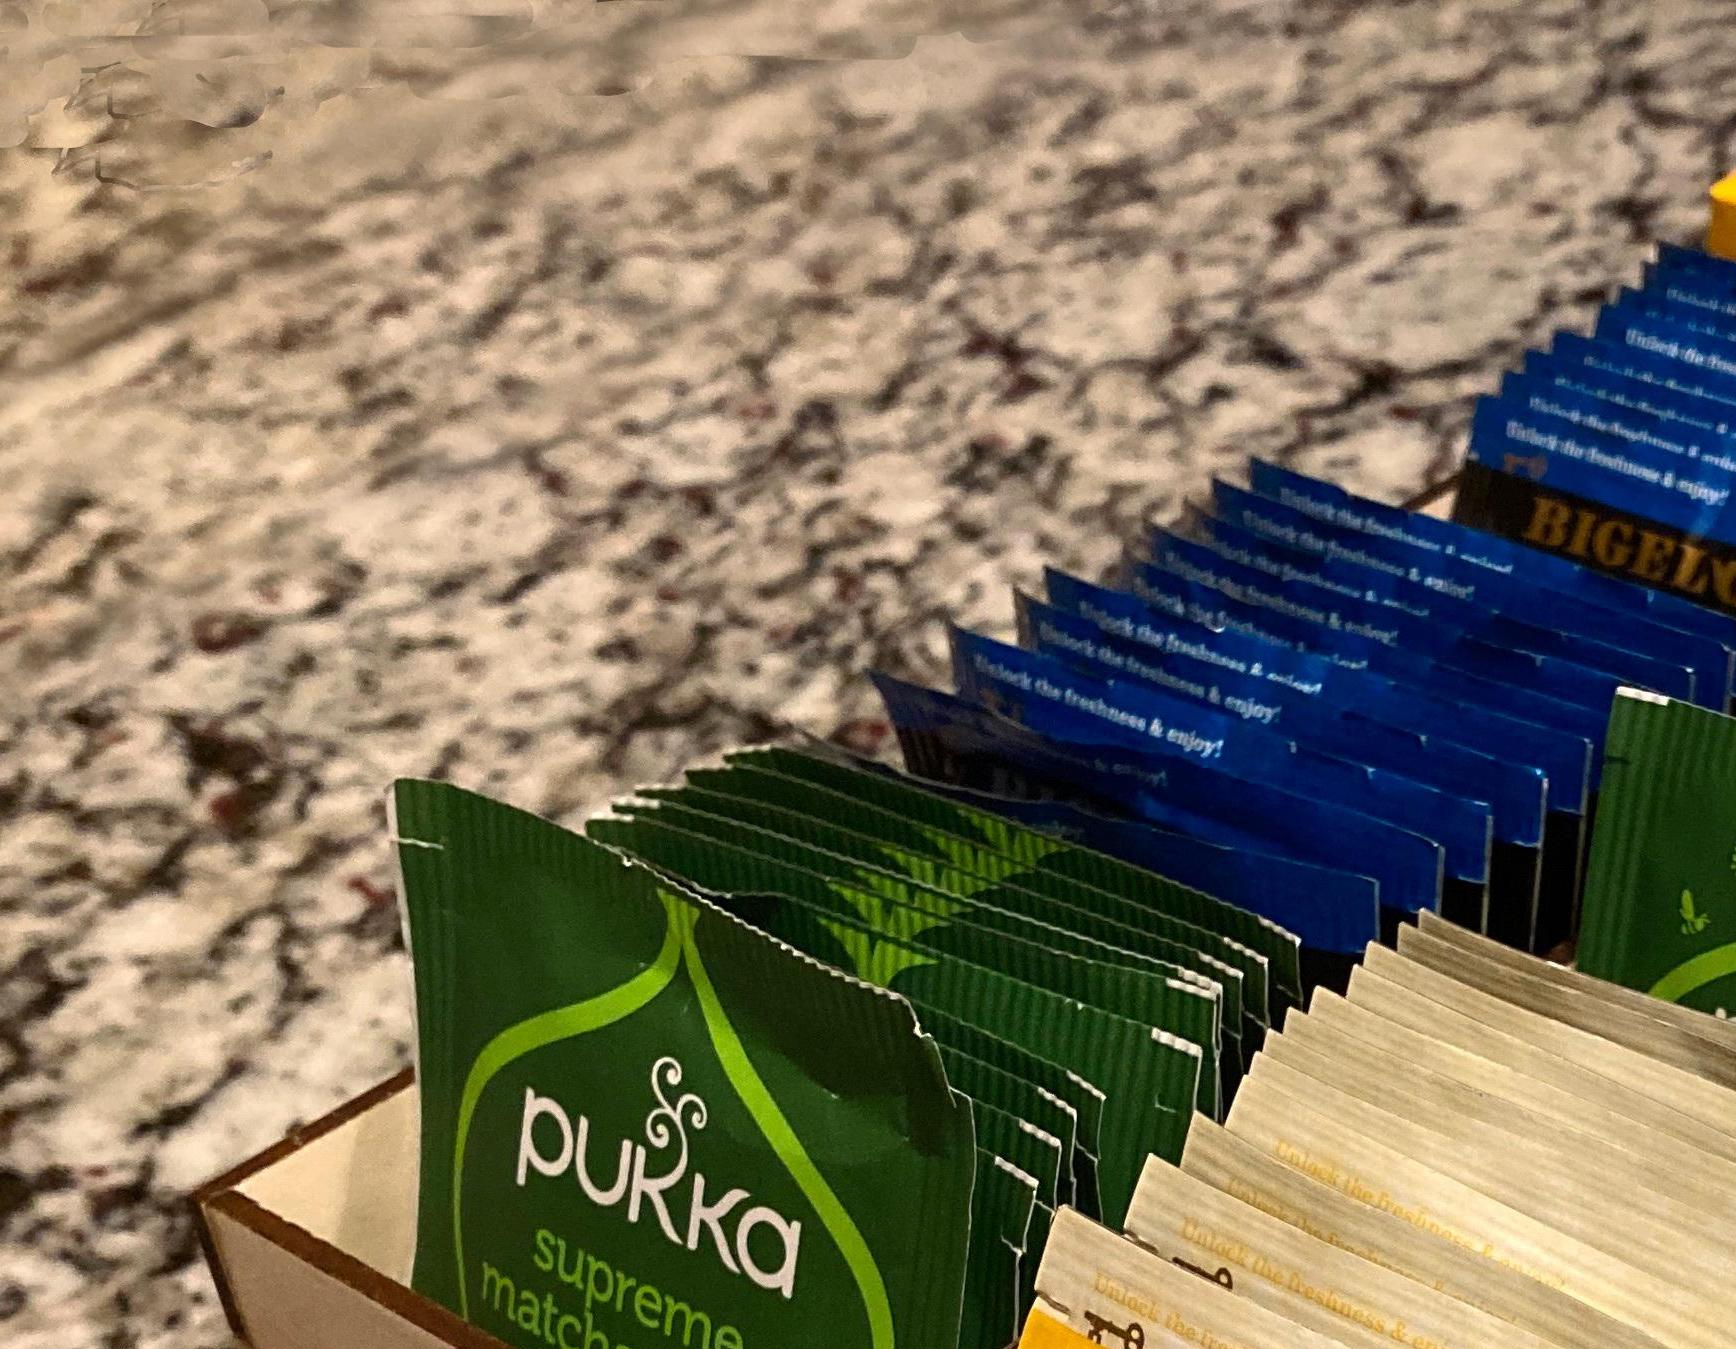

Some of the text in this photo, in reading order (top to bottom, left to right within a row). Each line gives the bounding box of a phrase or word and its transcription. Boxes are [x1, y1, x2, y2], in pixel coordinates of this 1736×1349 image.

[973, 652, 1033, 690] Unlock
[1034, 678, 1063, 700] the
[1065, 688, 1147, 731] freshness
[1166, 728, 1224, 758] enjoy!
[1040, 621, 1097, 659] Unlock
[1098, 647, 1126, 669] the
[1126, 655, 1206, 698] freshness
[516, 1058, 802, 1300] pukka
[1275, 1139, 1339, 1186] Unlock
[1344, 1173, 1376, 1201] the
[1092, 1271, 1160, 1323] Unlock
[1165, 1311, 1197, 1339] the
[1180, 1216, 1248, 1267] Unlock
[1252, 1255, 1286, 1286] the
[1287, 1273, 1389, 1334] freshness
